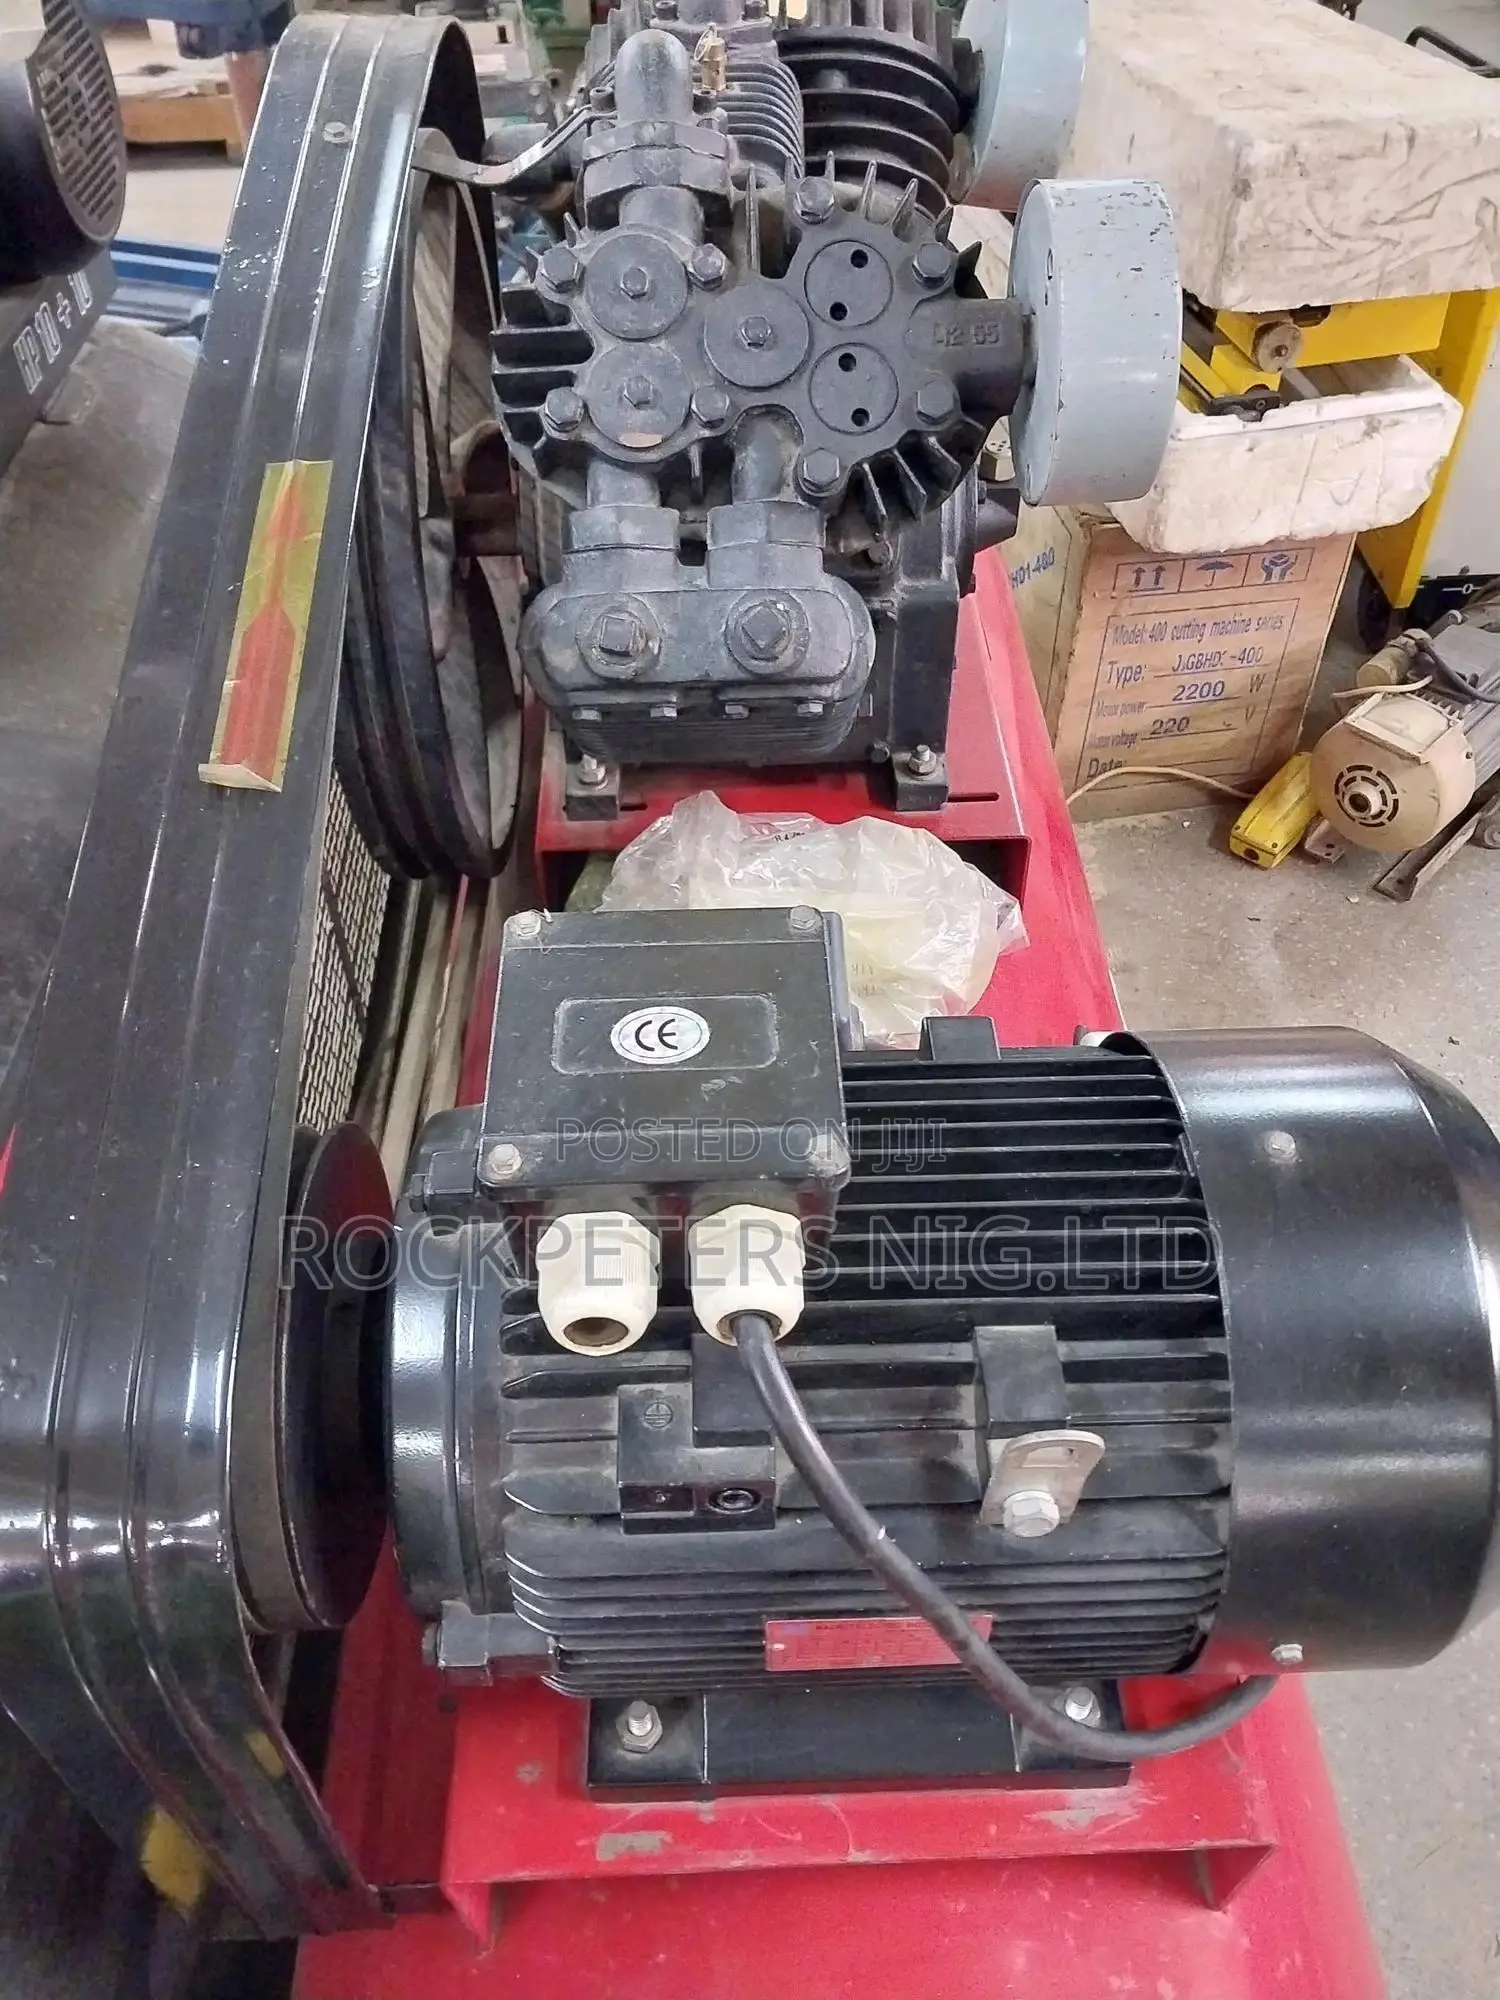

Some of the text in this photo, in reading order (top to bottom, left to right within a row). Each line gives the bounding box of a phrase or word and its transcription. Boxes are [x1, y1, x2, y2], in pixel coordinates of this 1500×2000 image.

[1149, 620, 1168, 642] 400
[1171, 617, 1205, 643] cutting
[1209, 612, 1252, 636] machine
[1255, 614, 1284, 632] series
[1107, 661, 1147, 690] Type:
[1172, 673, 1266, 702] 2200 W
[1150, 717, 1190, 736] 220
[634, 1018, 679, 1052] CE
